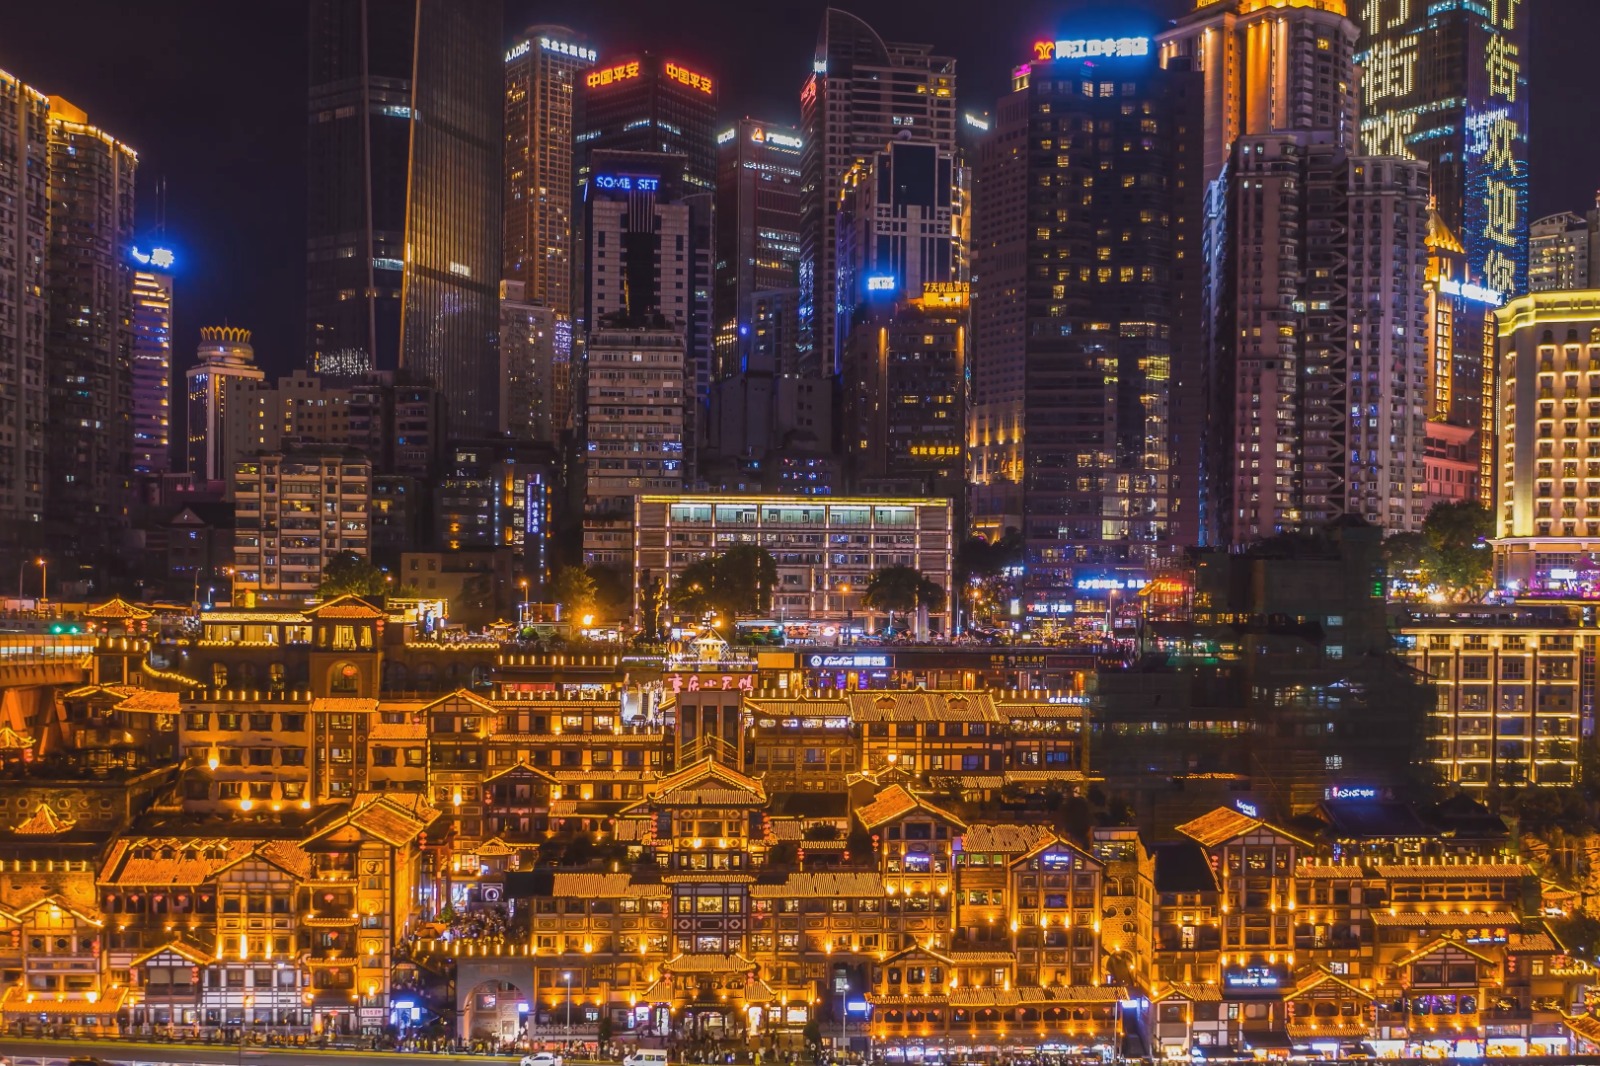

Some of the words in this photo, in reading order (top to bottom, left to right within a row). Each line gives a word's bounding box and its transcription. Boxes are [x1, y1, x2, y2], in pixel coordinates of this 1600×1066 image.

[587, 62, 640, 88] 中国平安
[666, 63, 712, 94] 中国平安
